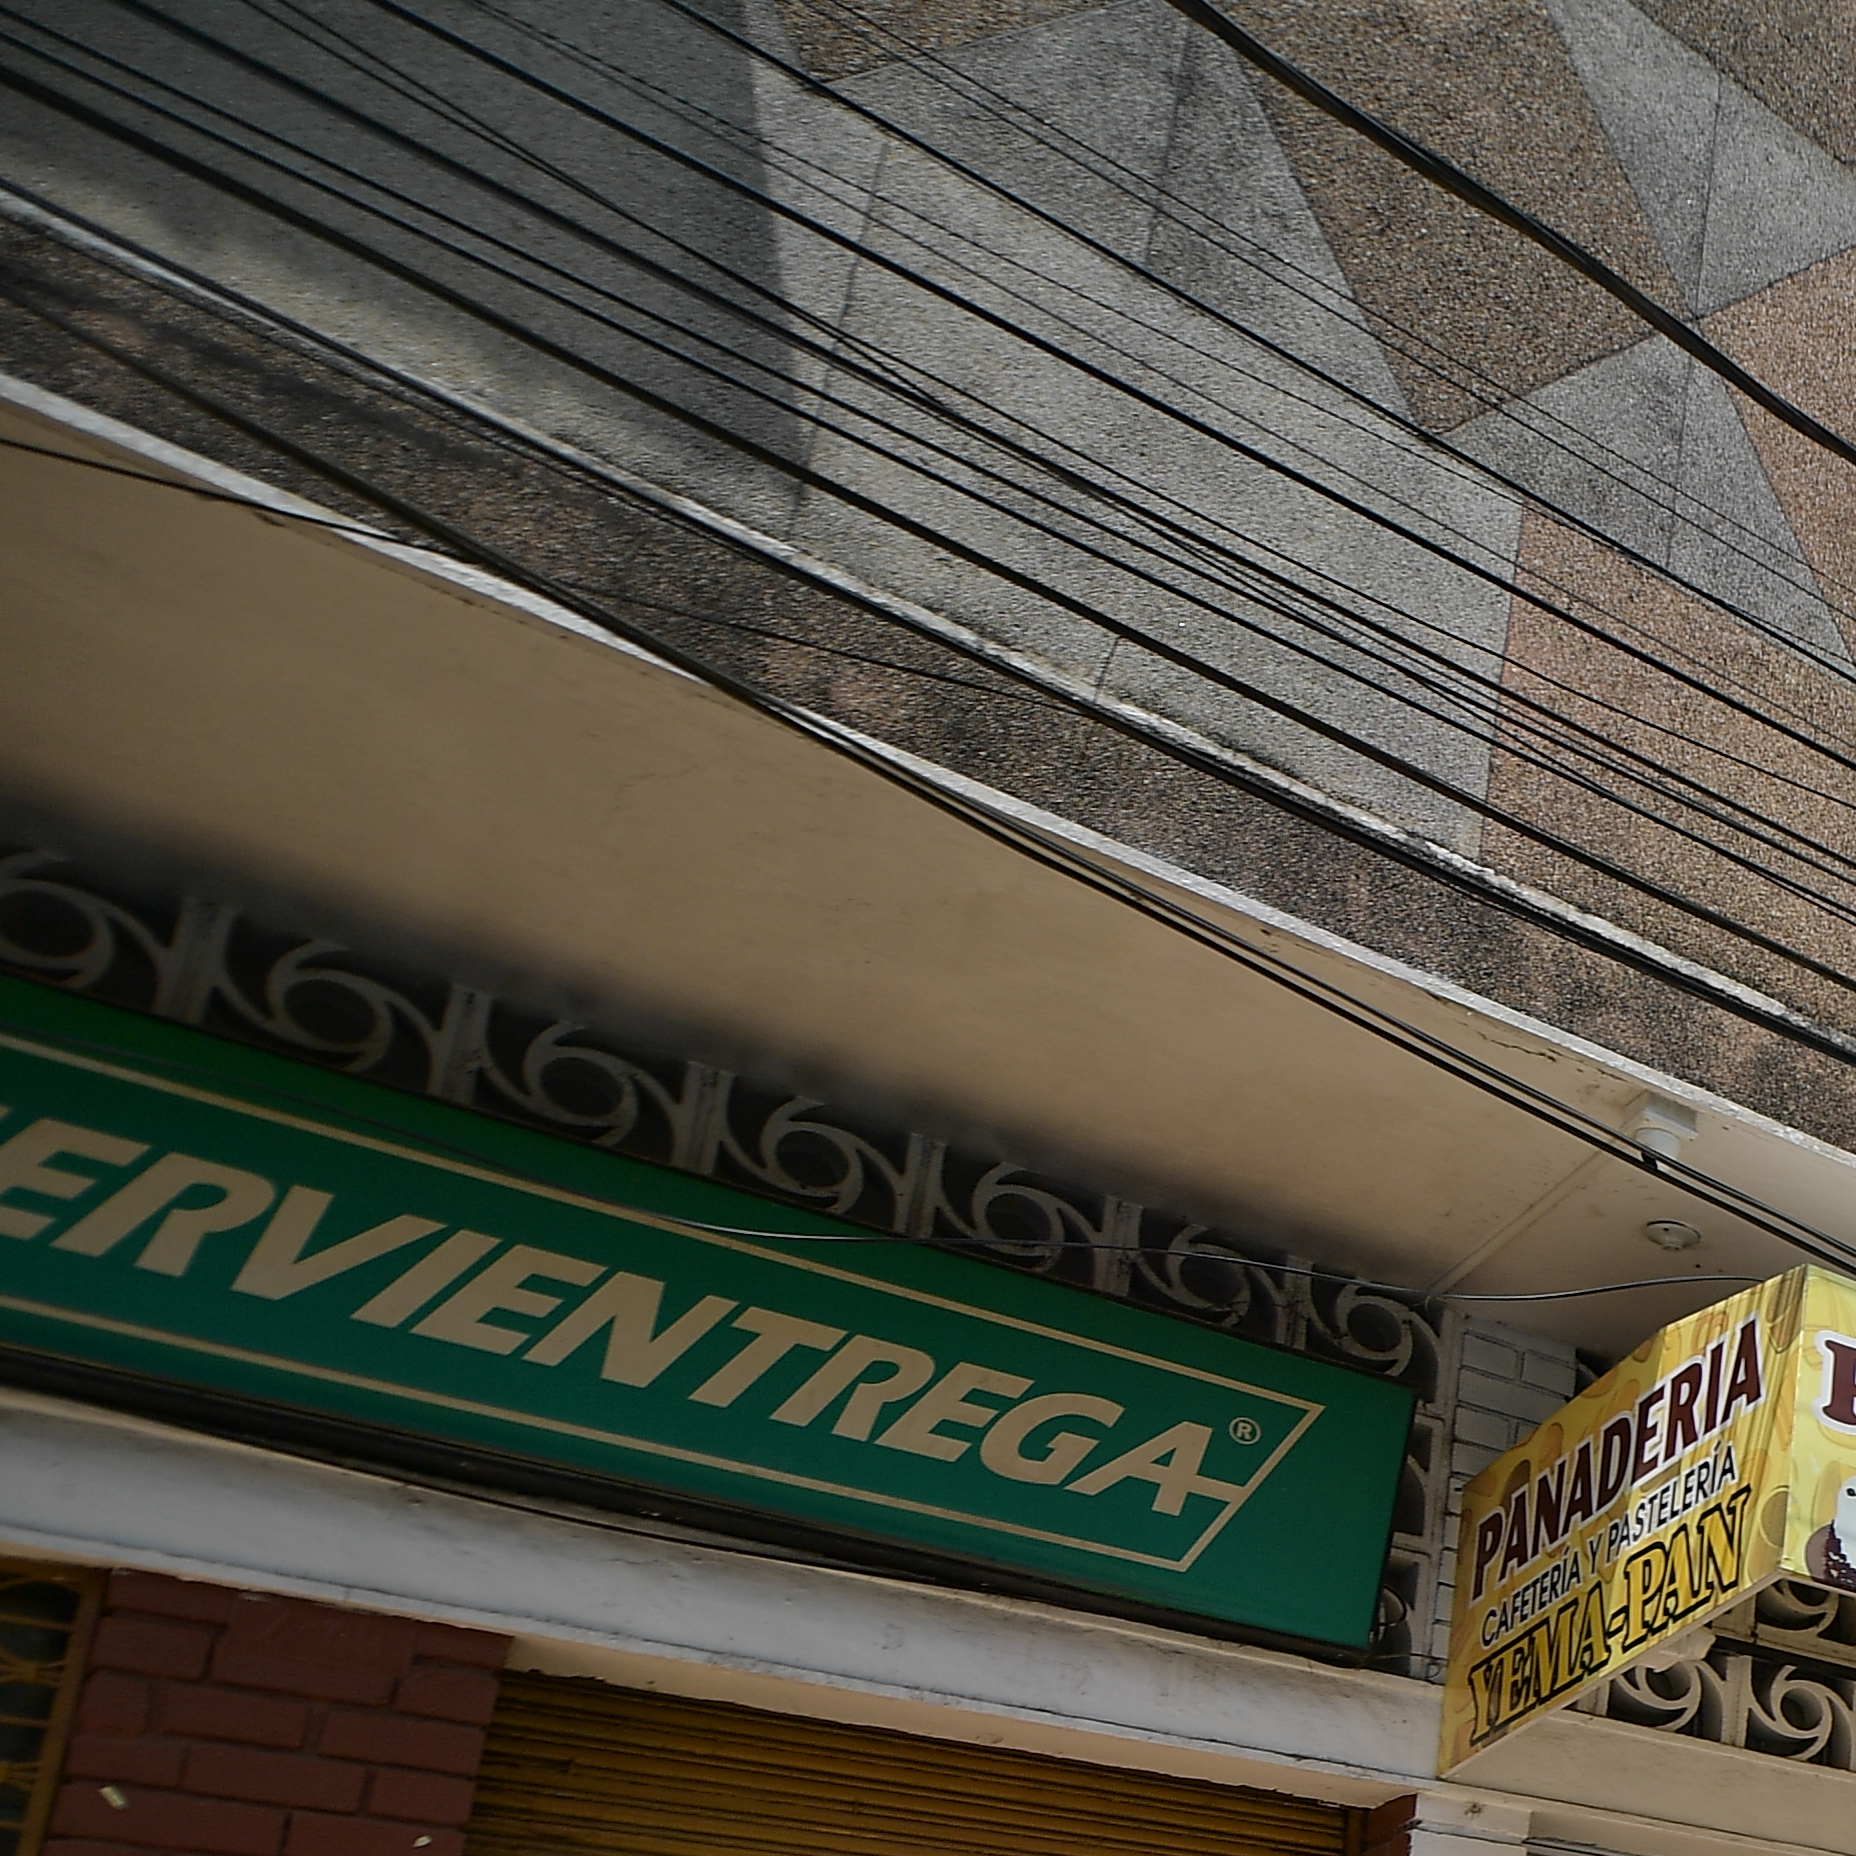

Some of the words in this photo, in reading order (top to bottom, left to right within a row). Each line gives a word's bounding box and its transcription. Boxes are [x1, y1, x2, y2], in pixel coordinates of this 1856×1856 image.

[0, 1106, 1214, 1517] ERVIENTREGA
[1473, 1318, 1763, 1602] PANADERIA
[1481, 1542, 1581, 1648] CAFETERÍA
[1586, 1533, 1605, 1575] Y
[1604, 1442, 1738, 1565] PASTELERÍA
[1468, 1483, 1752, 1746] YEMA-PAN
